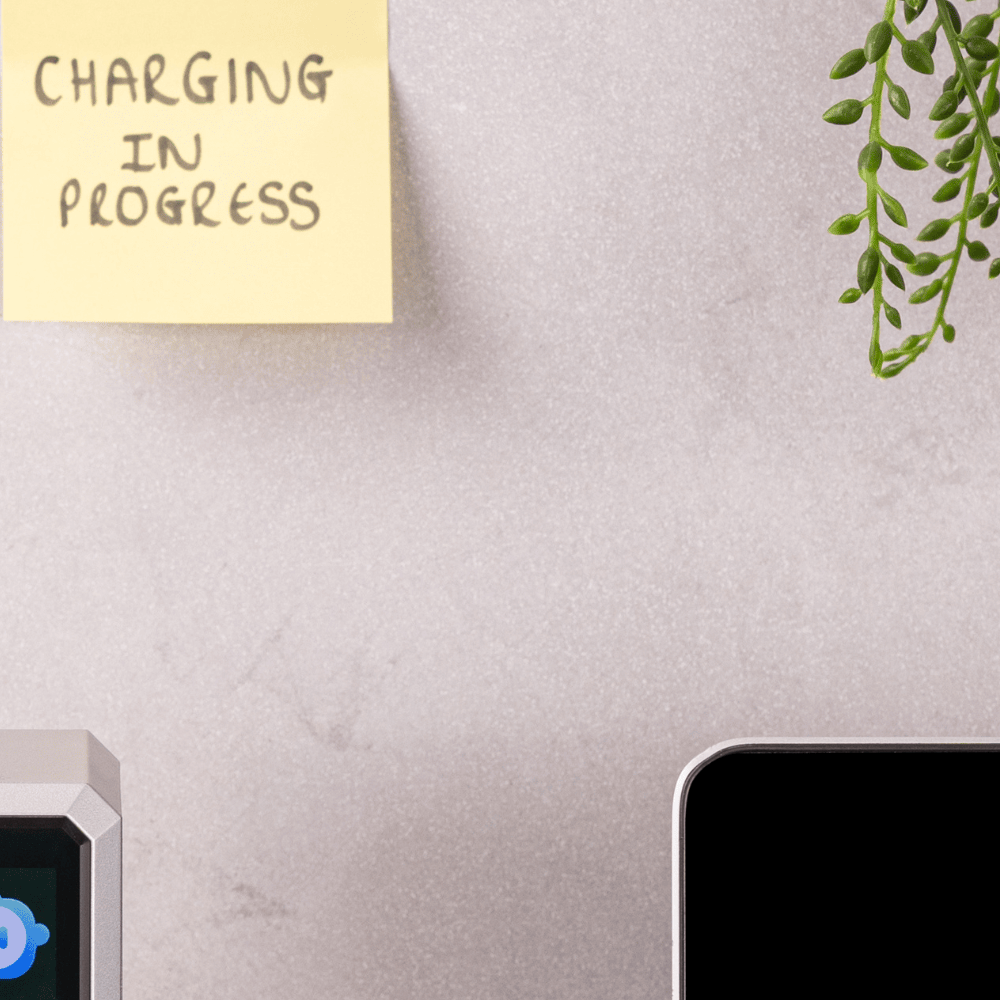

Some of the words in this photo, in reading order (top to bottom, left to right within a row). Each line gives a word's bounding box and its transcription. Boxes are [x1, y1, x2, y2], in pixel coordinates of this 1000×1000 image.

[34, 51, 334, 107] CHARGING
[120, 133, 203, 173] IN
[59, 178, 321, 231] PROGRESS
